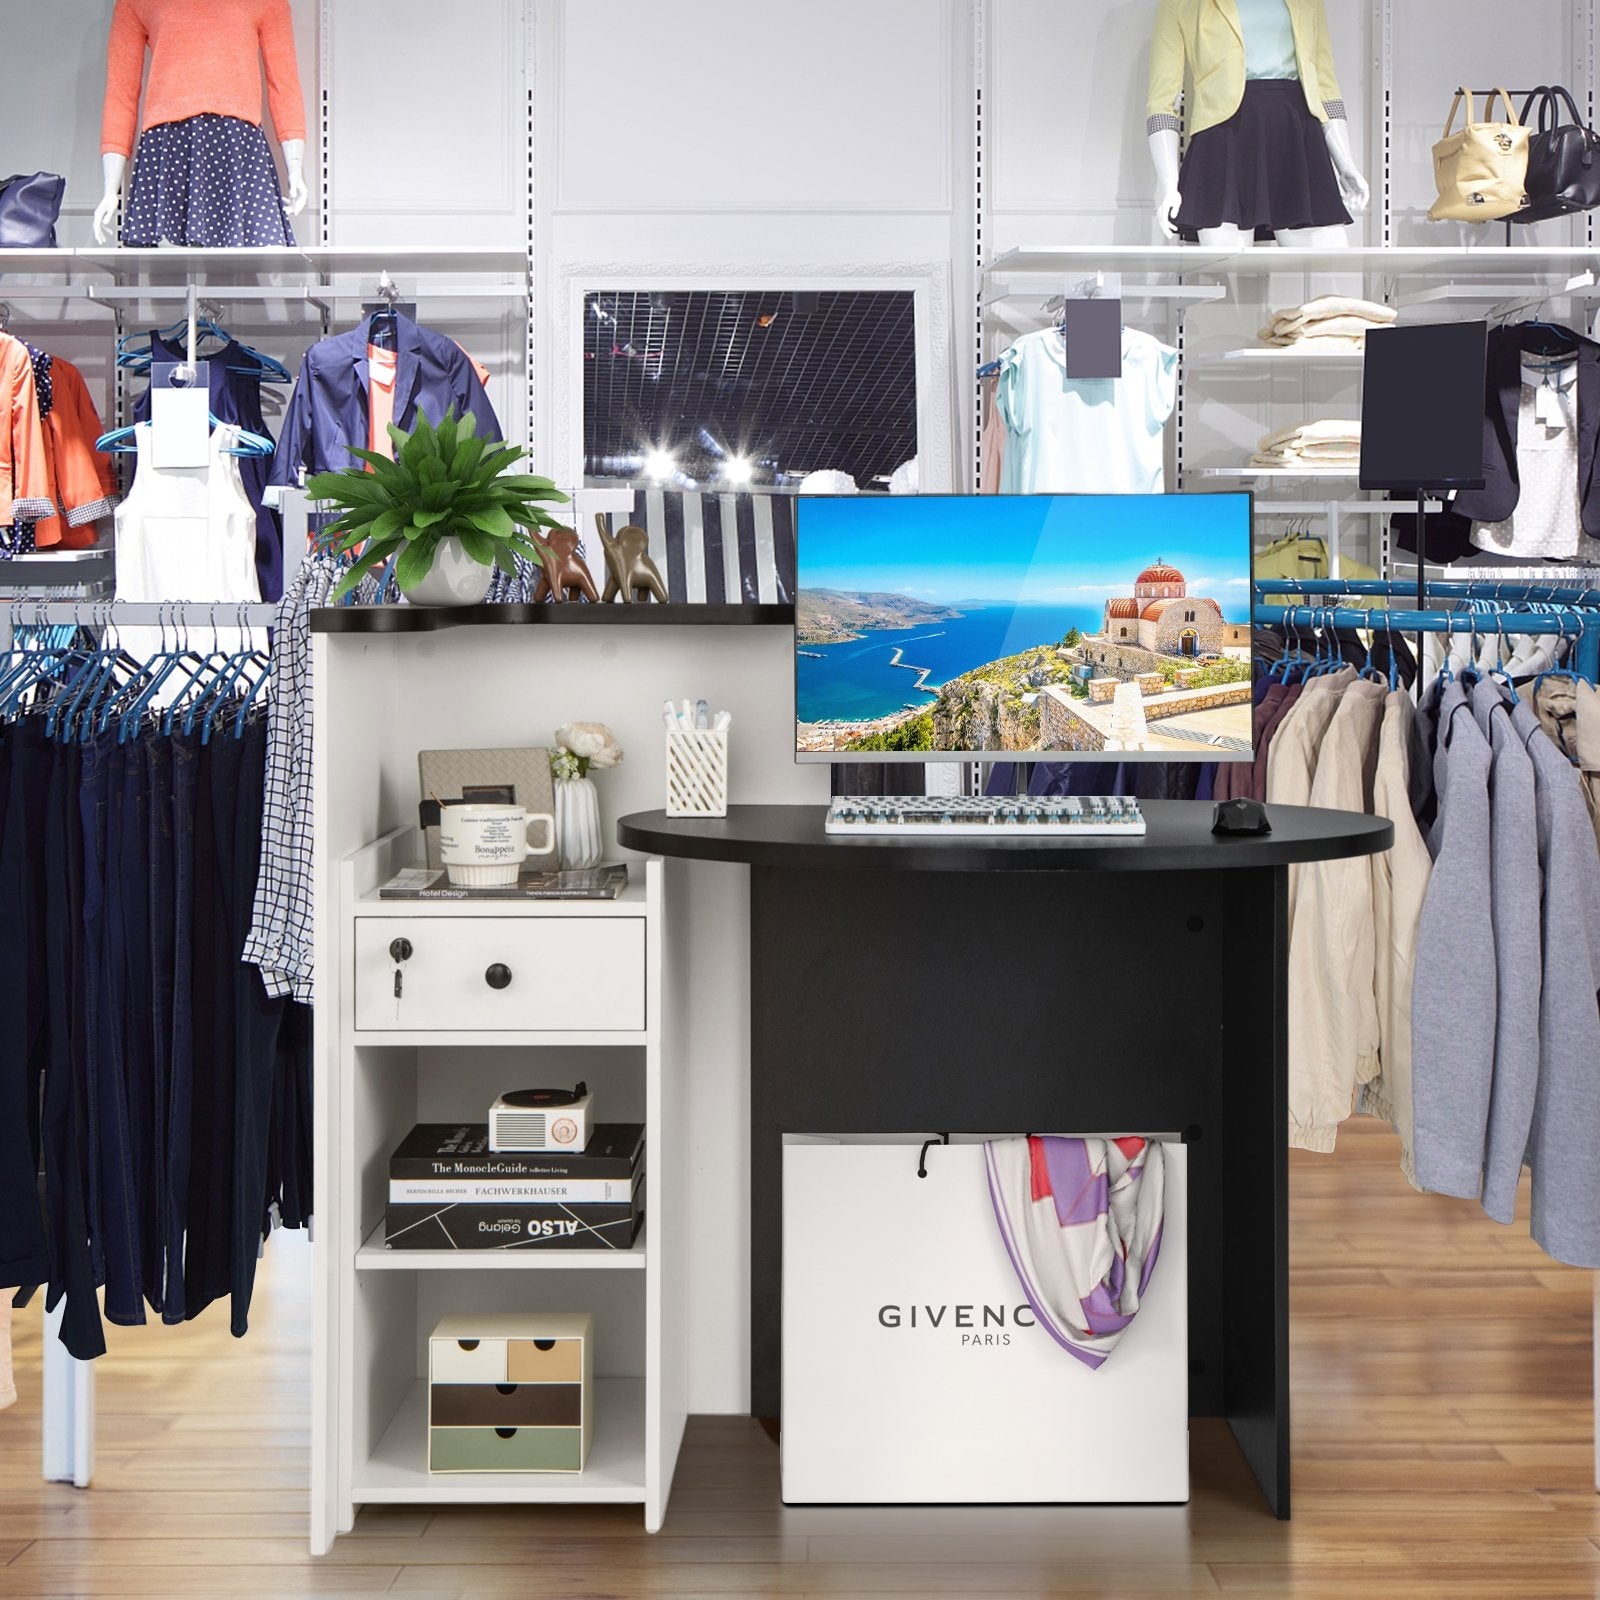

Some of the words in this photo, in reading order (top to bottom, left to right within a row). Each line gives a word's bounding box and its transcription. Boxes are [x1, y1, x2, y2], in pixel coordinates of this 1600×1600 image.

[419, 890, 441, 898] Hotel
[441, 890, 468, 899] Design
[432, 1162, 452, 1174] The
[475, 1187, 568, 1196] FACHWERKHAUSER
[478, 1221, 521, 1234] Gelang
[527, 1219, 579, 1236] ALSO
[878, 1304, 1036, 1328] GIVENC
[961, 1333, 1012, 1347] PARIS
